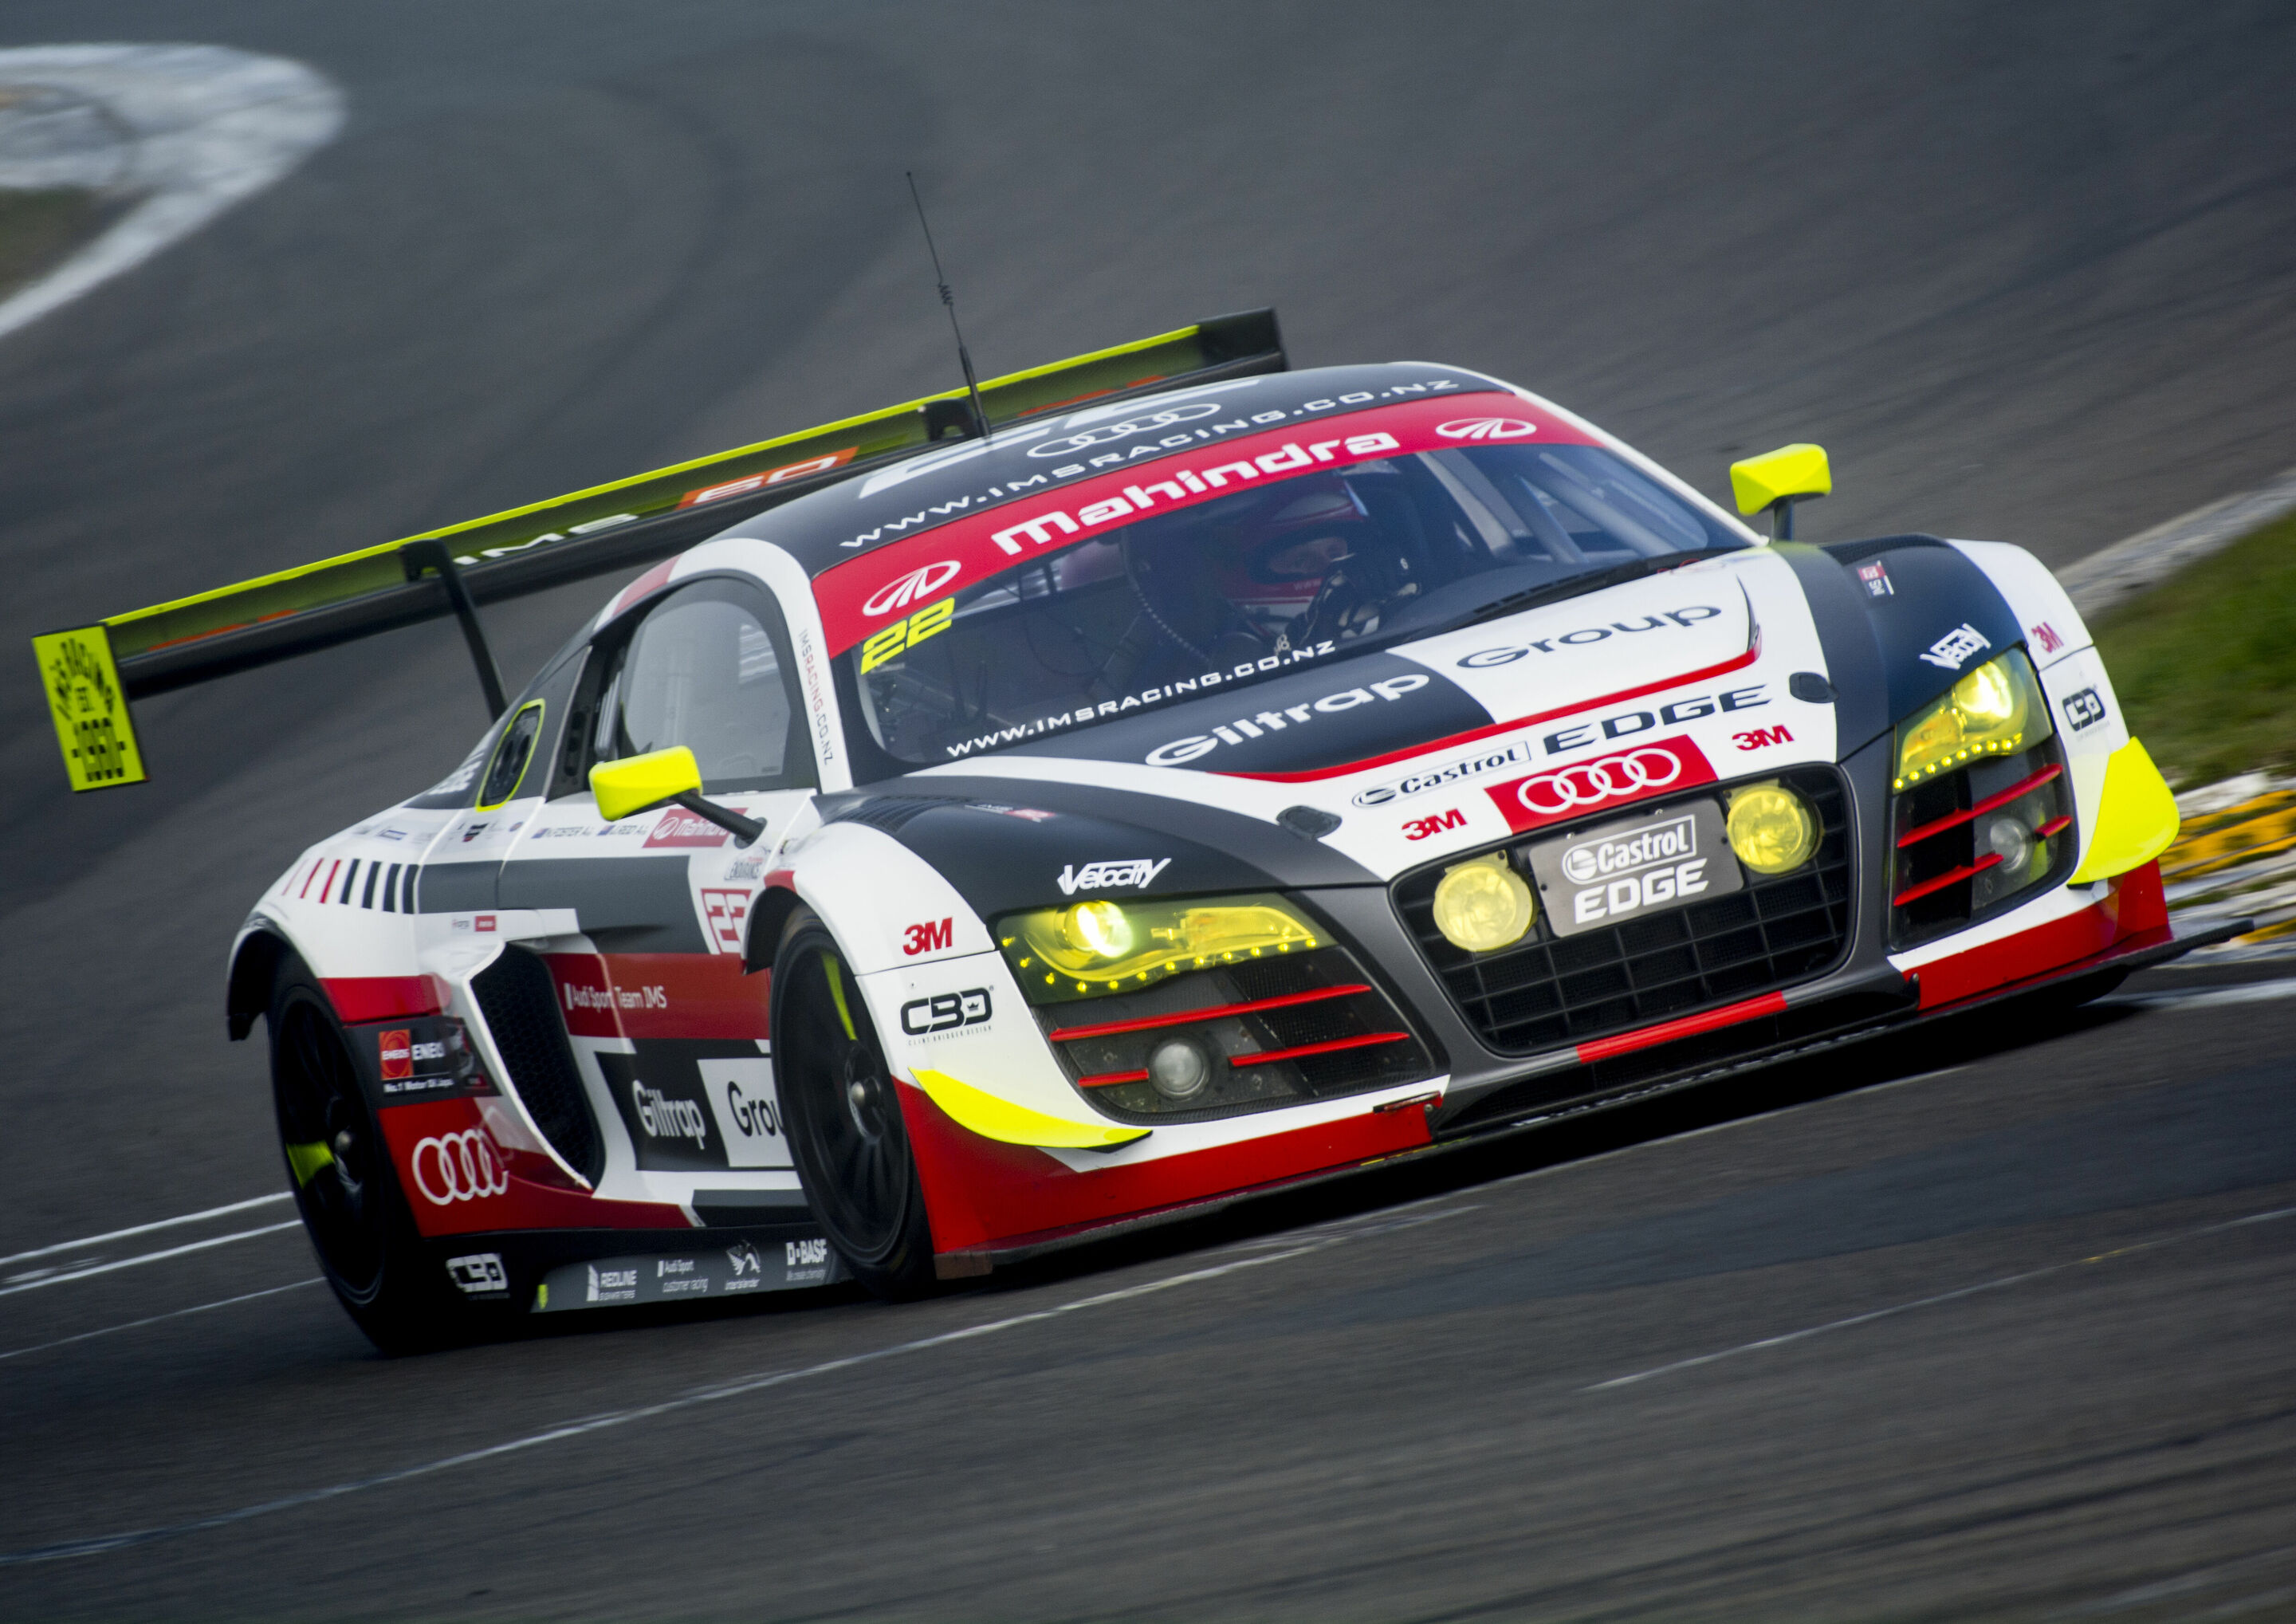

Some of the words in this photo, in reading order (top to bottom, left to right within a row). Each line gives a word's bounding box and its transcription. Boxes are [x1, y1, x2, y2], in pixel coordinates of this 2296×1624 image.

[860, 597, 955, 674] 22
[2031, 621, 2065, 654] 3M
[946, 640, 1336, 757] WWW.IMSRACING.CO.NZ
[1145, 674, 1430, 766] Giltrap
[1456, 604, 1722, 669] Group
[1400, 749, 1521, 794] Castrol
[1543, 684, 1773, 756] EDGE
[1731, 724, 1795, 752] 3M
[1401, 808, 1468, 841] 3M
[1597, 823, 1690, 874] Castrol
[1057, 858, 1172, 895] Velocity
[1574, 857, 1709, 925] EDGE
[902, 917, 953, 956] 3M
[614, 985, 644, 1009] Team
[642, 985, 667, 1009] IMS
[632, 1079, 706, 1150] Giltrap
[727, 1080, 786, 1138] Grou
